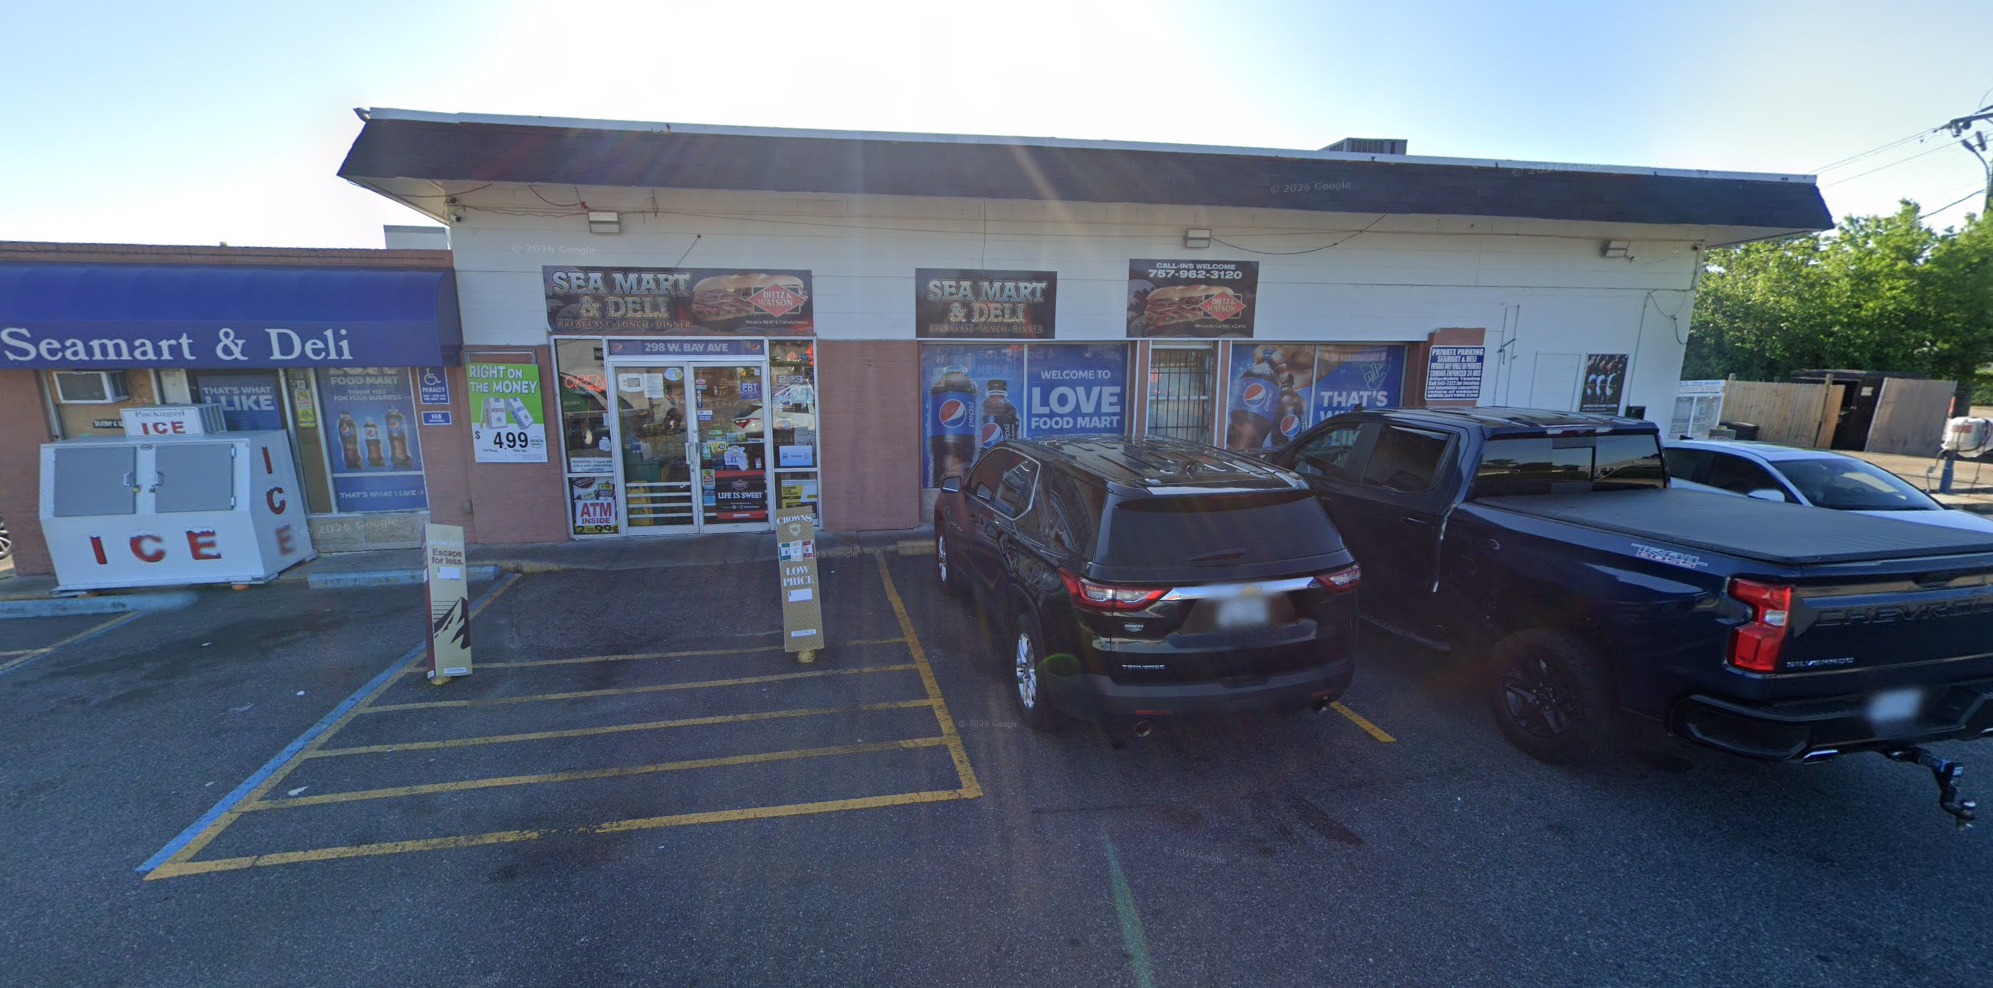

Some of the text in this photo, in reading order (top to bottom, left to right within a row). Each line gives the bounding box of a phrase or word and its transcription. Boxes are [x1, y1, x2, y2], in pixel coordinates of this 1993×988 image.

[1156, 262, 1194, 270] CALL-INS
[1148, 269, 1242, 279] 757-962-3120
[552, 271, 692, 296] SEA MART
[763, 291, 792, 299] DIETZ &
[928, 280, 1047, 302] SEA MART
[580, 294, 670, 318] & DELI
[758, 298, 794, 306] WATSON
[1207, 304, 1236, 312] WATSON
[950, 302, 1025, 322] & DELI
[559, 320, 692, 328] BREAKFAST LUNCH DINNER
[928, 324, 1044, 334] BREAKFAST LUNCH DINNER
[1, 328, 354, 361] Seamart & Deli
[644, 343, 728, 352] 298 W. BAY AVE
[1432, 348, 1484, 356] PRIVATE PARKING
[470, 364, 522, 379] RIGHT ON
[1041, 370, 1110, 380] WELCOME TO
[330, 376, 399, 386] FOOD MART
[470, 380, 538, 394] THE MONEY
[565, 374, 606, 390] OPEN
[742, 382, 758, 392] EBT
[202, 386, 272, 395] THAT'S WHAT
[221, 394, 275, 412] LIKE
[1032, 386, 1120, 414] LOVE
[1320, 390, 1388, 407] THAT'S
[135, 410, 185, 418] Packaged
[141, 420, 186, 435] ICE
[1031, 416, 1120, 430] FOOD MART
[475, 430, 528, 450] $ 4.99
[1331, 430, 1362, 446] LIK
[580, 502, 612, 517] ATM
[776, 514, 812, 526] CROWNS
[88, 530, 222, 564] ICE
[432, 548, 462, 558] Escape
[432, 556, 464, 565] for less.
[786, 566, 809, 576] LOW
[783, 575, 814, 587] PRICE
[1786, 657, 1854, 668] SILVERADO
